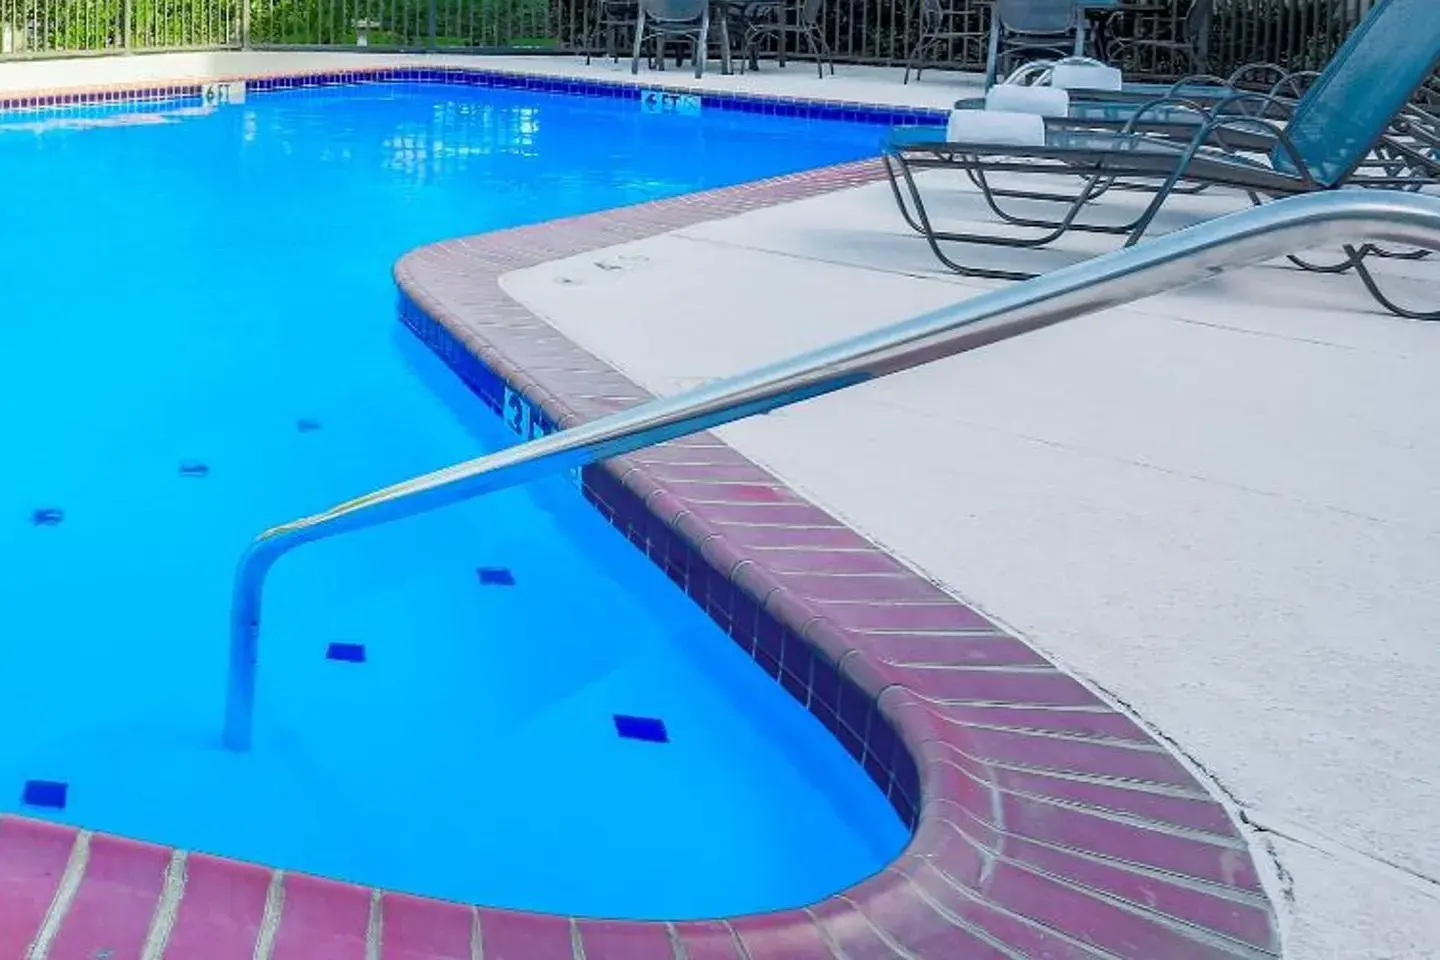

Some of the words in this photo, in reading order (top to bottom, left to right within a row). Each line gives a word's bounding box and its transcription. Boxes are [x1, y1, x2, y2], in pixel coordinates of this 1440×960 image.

[219, 84, 230, 100] FT
[662, 94, 679, 109] FT
[509, 393, 524, 436] 3
